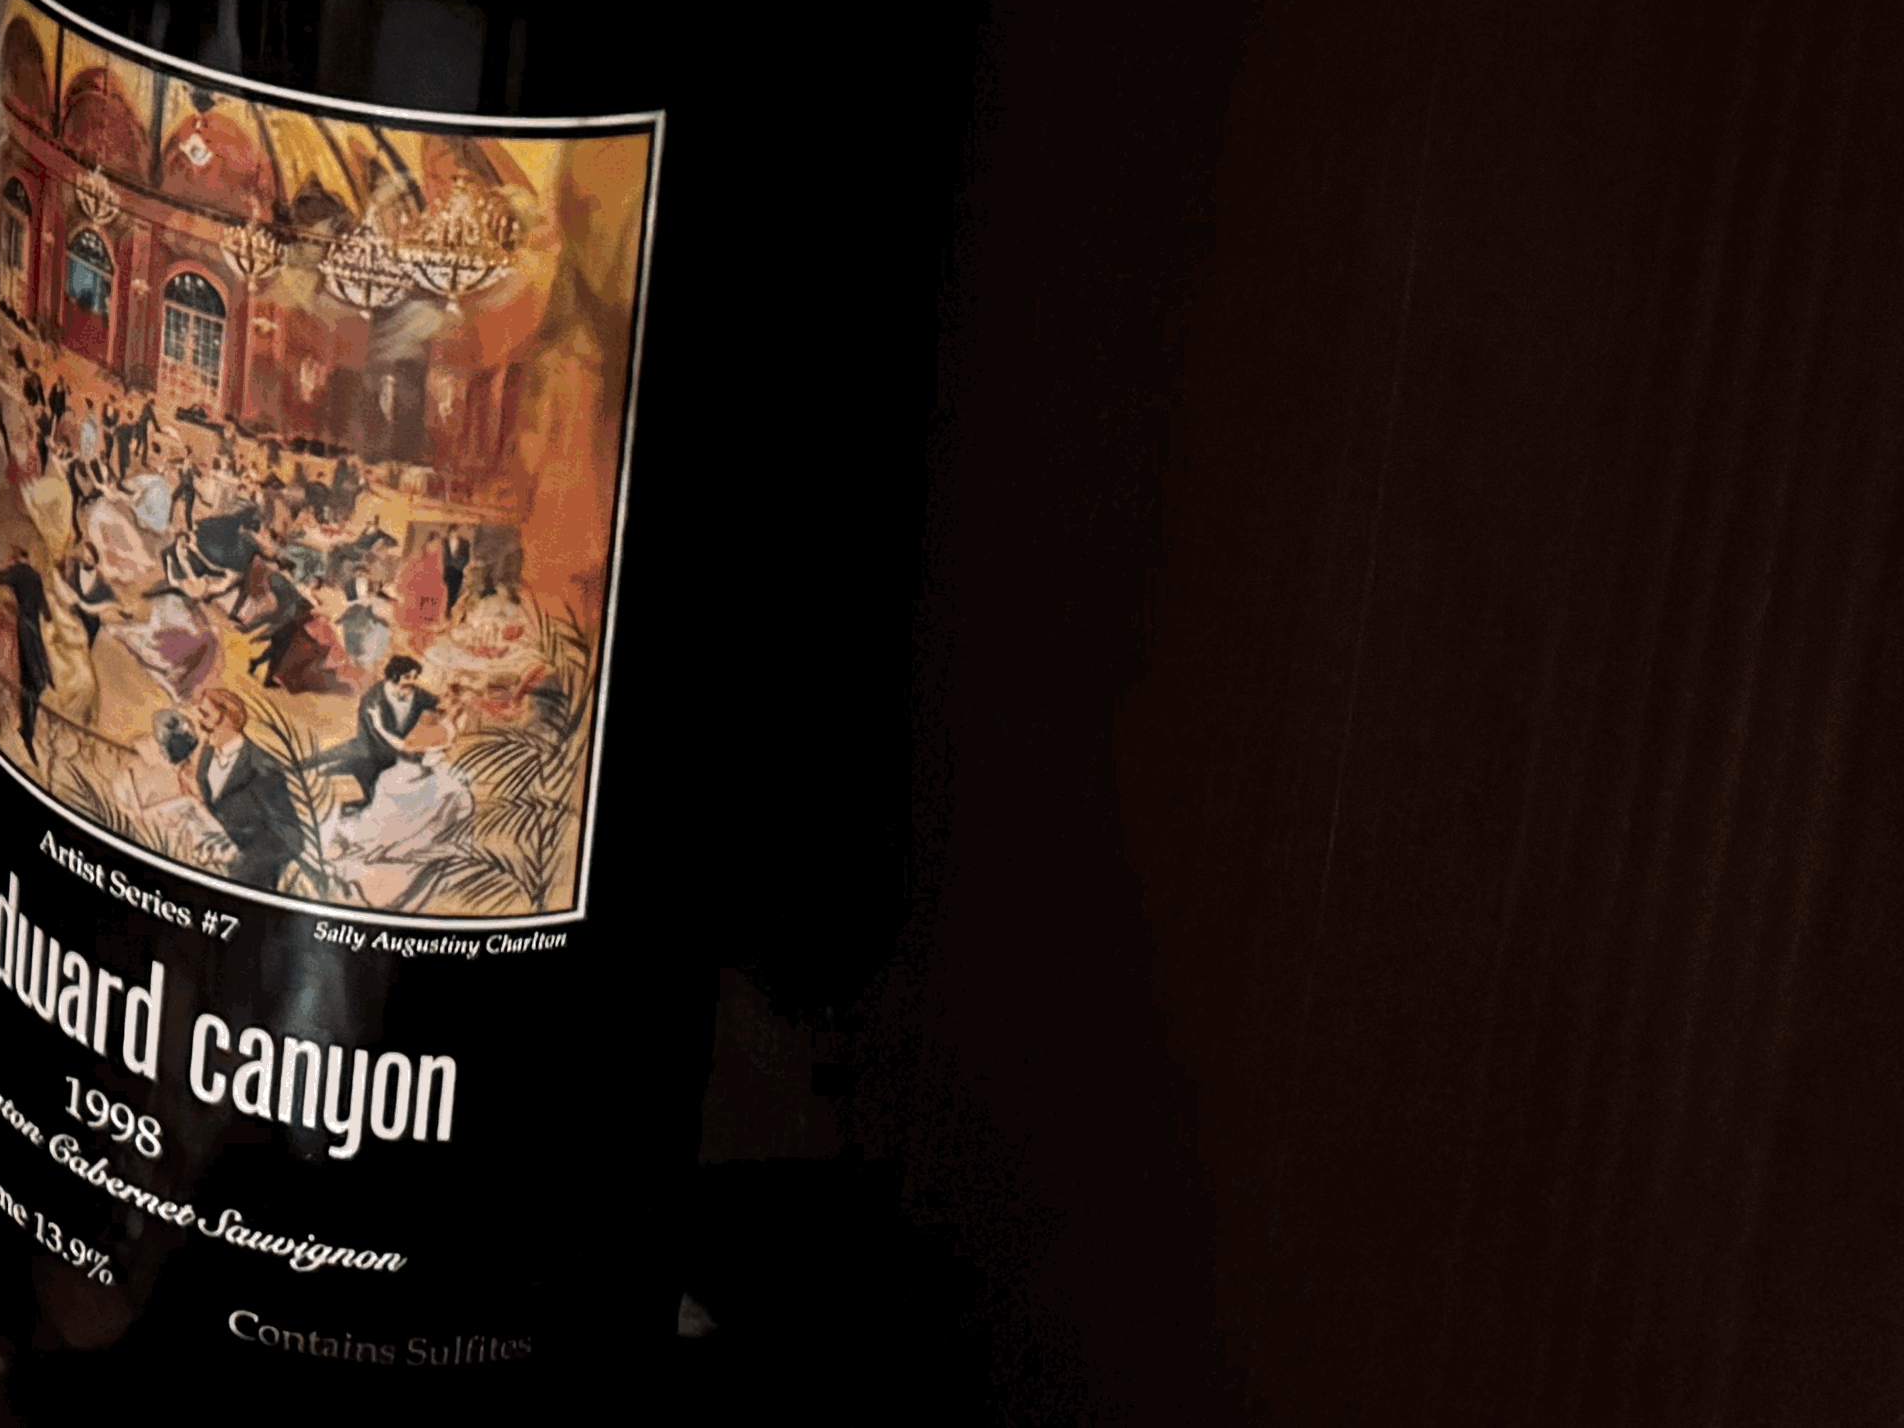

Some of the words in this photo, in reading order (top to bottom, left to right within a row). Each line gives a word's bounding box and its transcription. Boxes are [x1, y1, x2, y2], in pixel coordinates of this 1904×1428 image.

[40, 830, 105, 893] Artist
[109, 870, 192, 928] Series
[201, 910, 240, 942] #7
[314, 921, 366, 951] Sally
[372, 931, 480, 960] Augustiny
[486, 932, 567, 955] Charlton
[65, 1076, 164, 1159] 1998
[190, 1014, 457, 1160] canyon
[49, 1134, 197, 1226] Cabernet
[197, 1210, 408, 1271] Sauvignon
[34, 1212, 116, 1286] 13.9%
[228, 1310, 396, 1366] Contains
[406, 1334, 533, 1366] Sulfites
